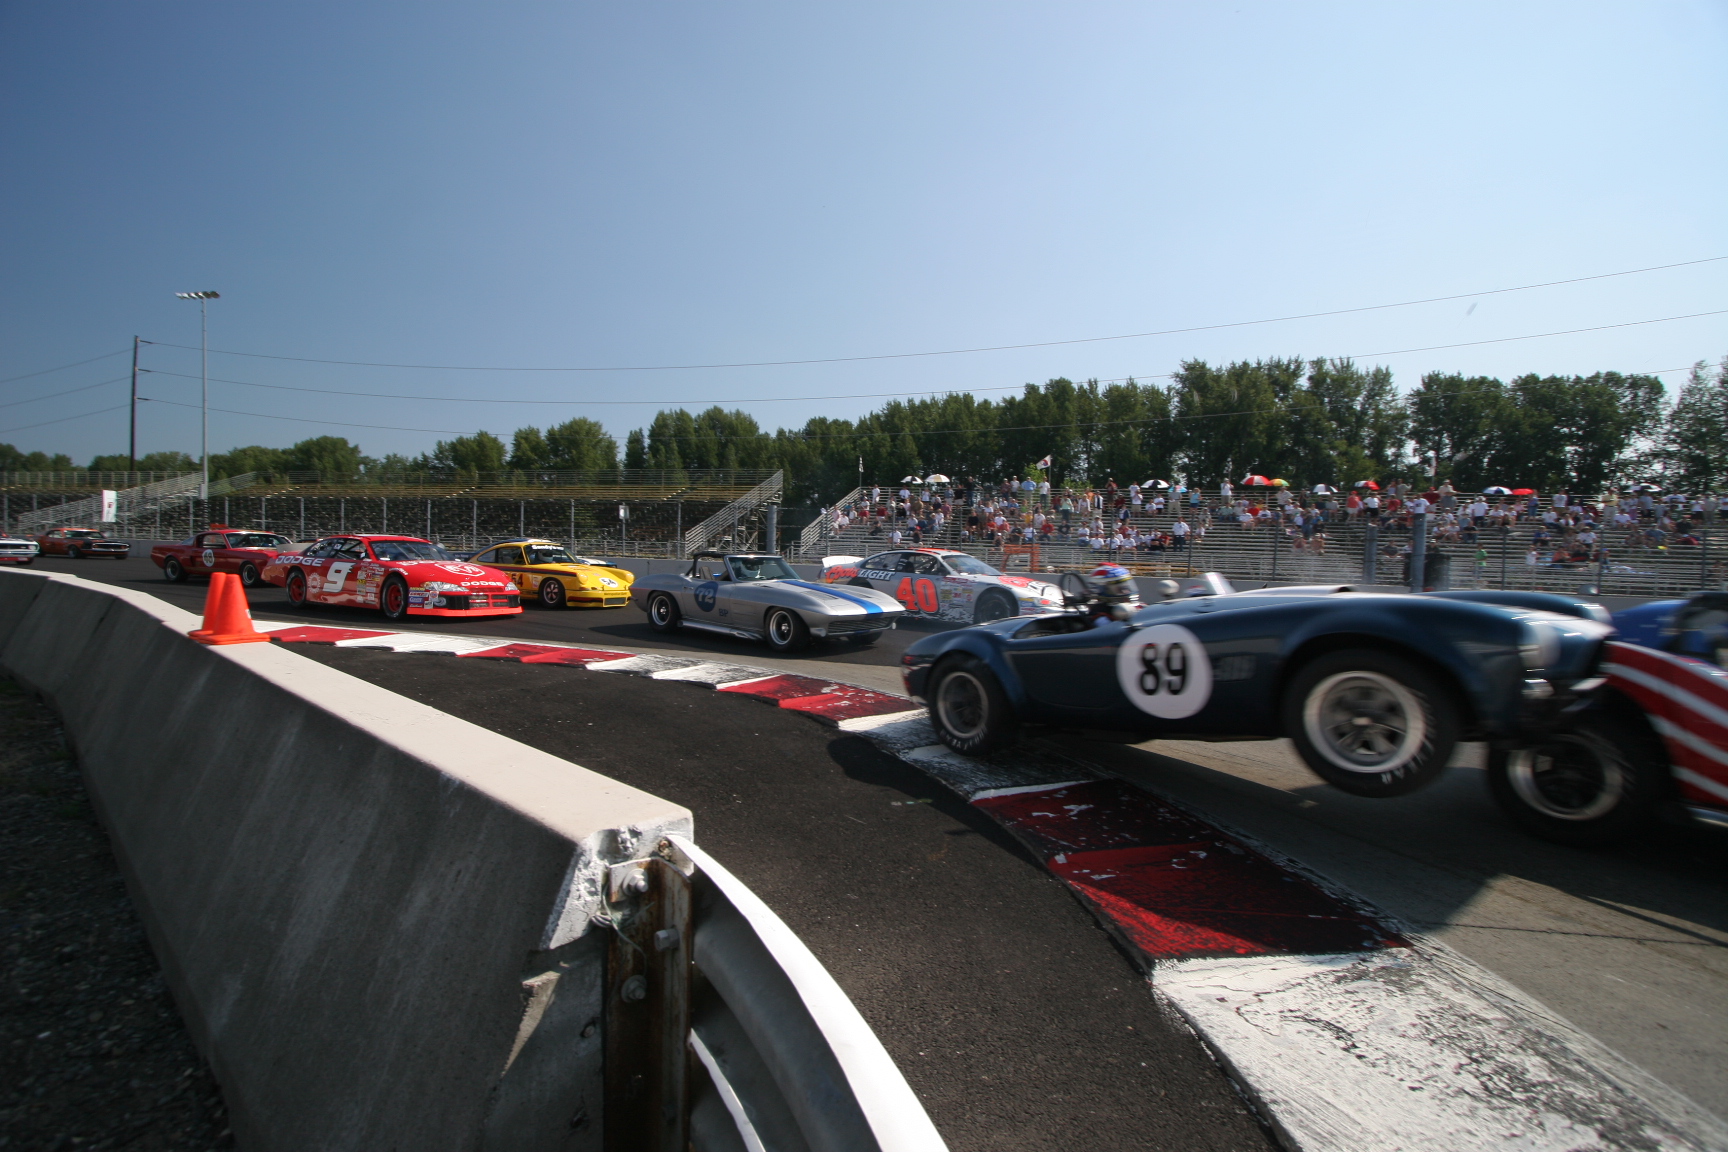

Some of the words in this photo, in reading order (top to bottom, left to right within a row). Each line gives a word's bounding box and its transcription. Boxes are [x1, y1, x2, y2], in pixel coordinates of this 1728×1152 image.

[275, 555, 325, 567] DODGE
[322, 561, 356, 593] 9
[857, 569, 895, 581] LIGHT
[696, 587, 714, 604] 72
[896, 577, 939, 613] 40
[718, 608, 729, 617] BP
[1138, 642, 1189, 696] 89
